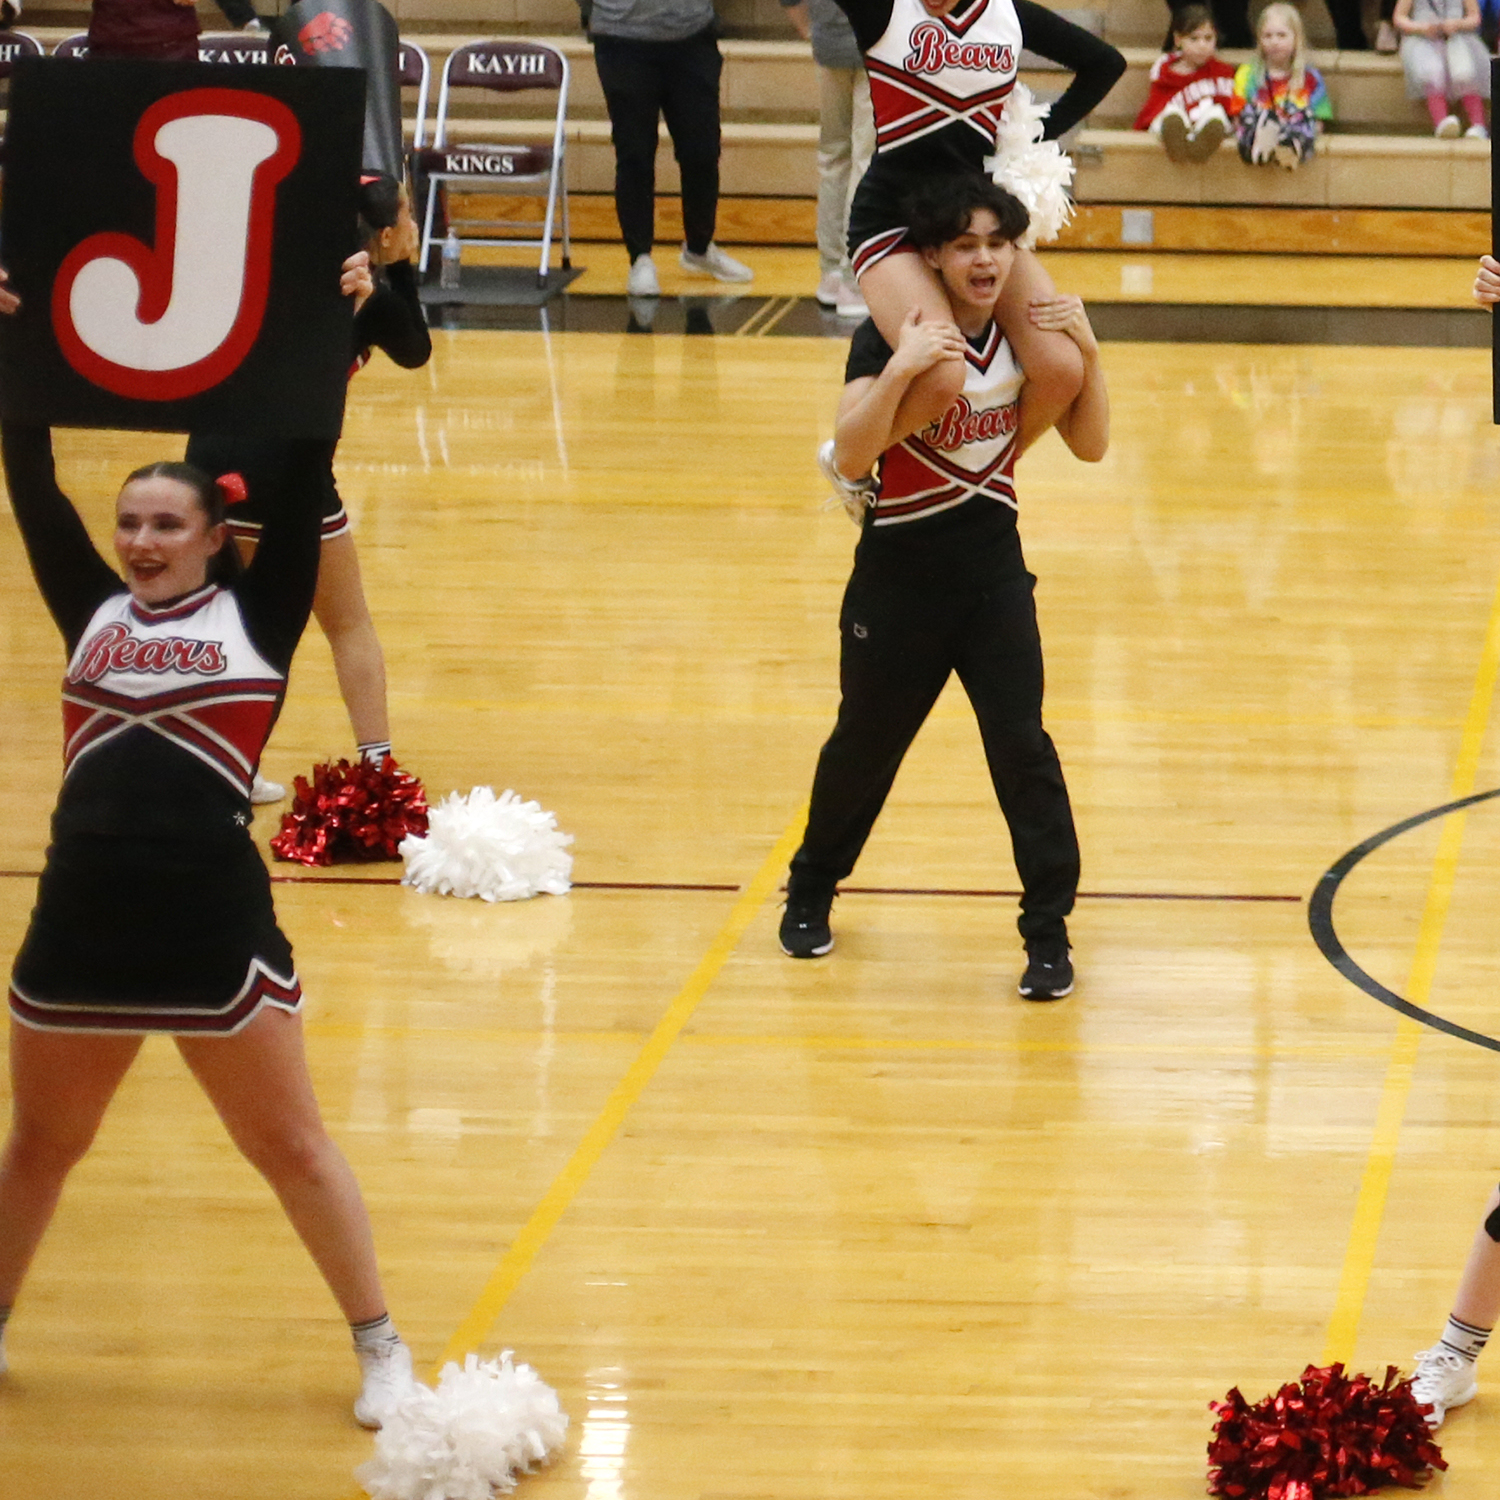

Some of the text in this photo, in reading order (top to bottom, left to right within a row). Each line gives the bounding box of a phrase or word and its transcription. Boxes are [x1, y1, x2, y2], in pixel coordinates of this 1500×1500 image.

[467, 53, 546, 74] KAYHI
[905, 21, 1015, 74] Bears
[445, 154, 514, 174] KINGS
[52, 87, 301, 400] J
[70, 621, 226, 685] Bears
